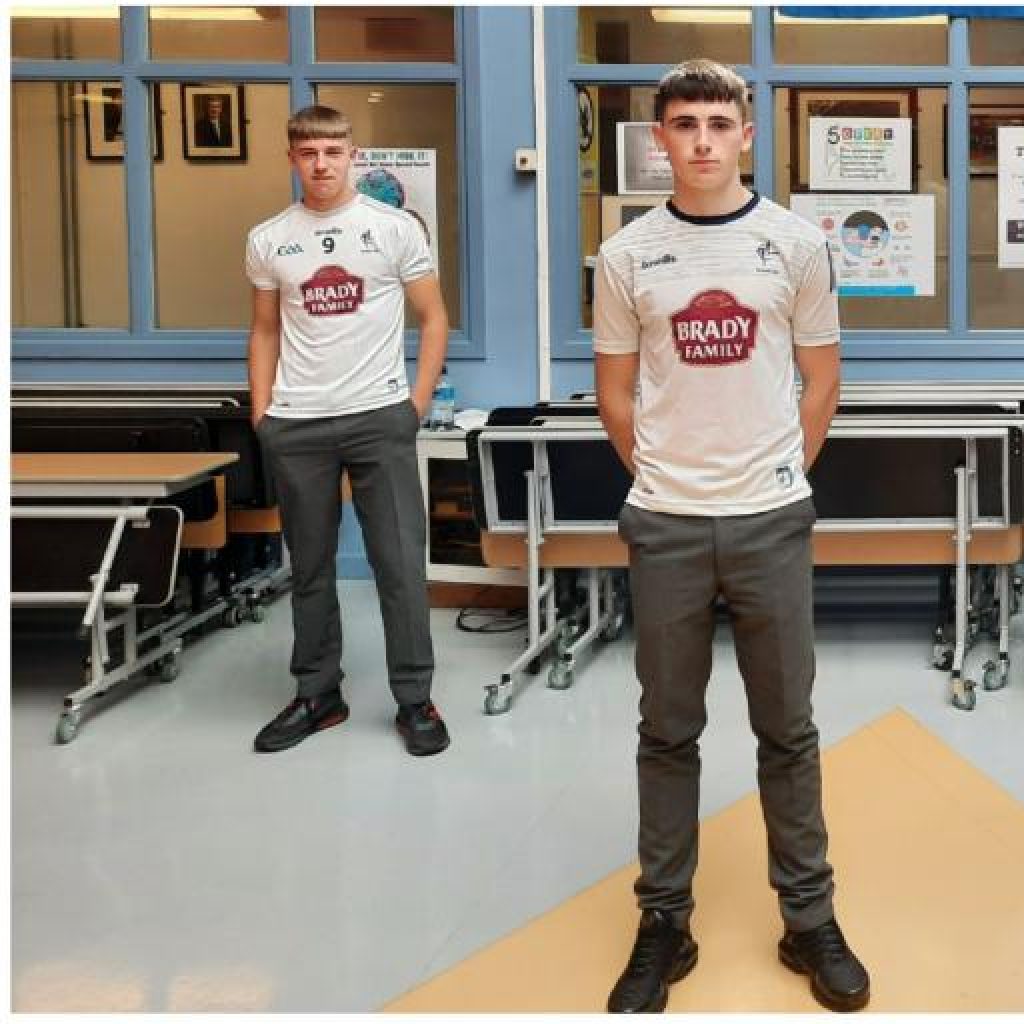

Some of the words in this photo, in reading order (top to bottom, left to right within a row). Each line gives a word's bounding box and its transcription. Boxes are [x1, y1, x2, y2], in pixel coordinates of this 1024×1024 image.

[826, 126, 841, 145] 5
[321, 236, 336, 254] 9
[305, 282, 359, 302] BRADY
[676, 315, 752, 343] BRADY
[684, 343, 744, 360] FAMILY
